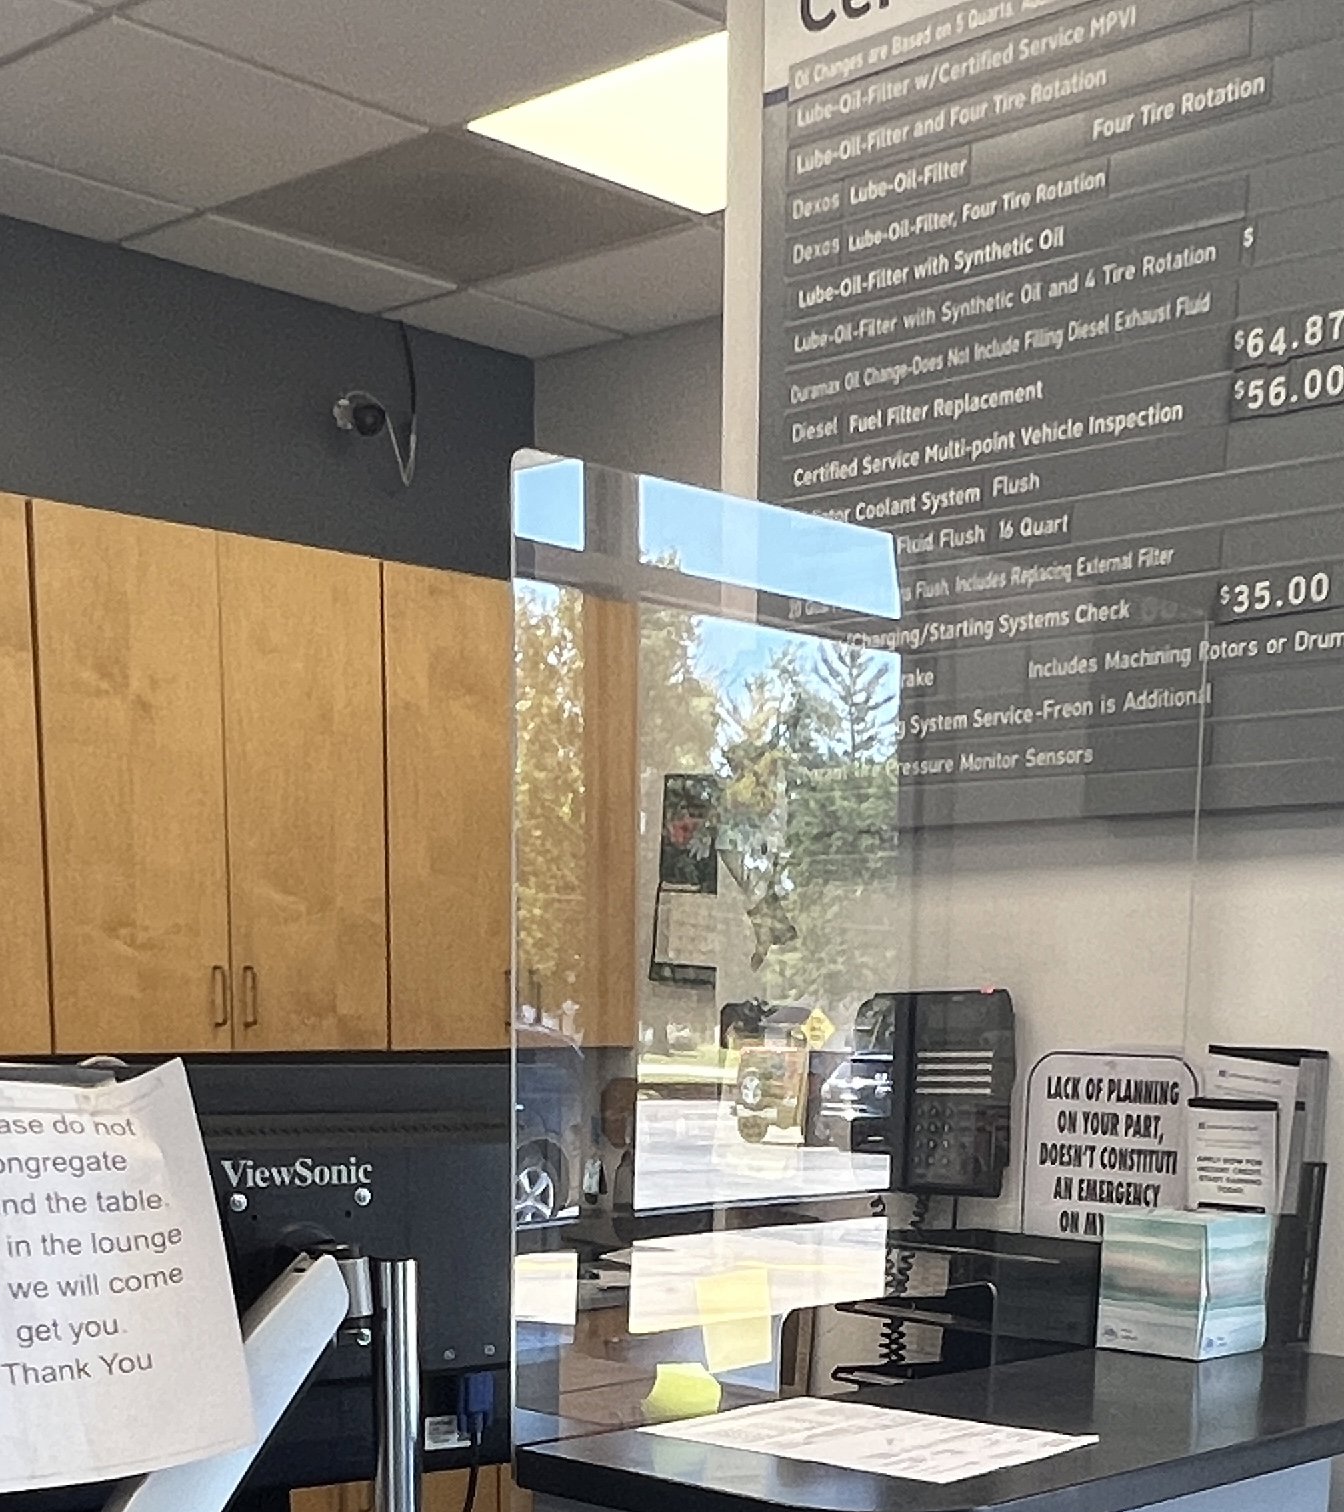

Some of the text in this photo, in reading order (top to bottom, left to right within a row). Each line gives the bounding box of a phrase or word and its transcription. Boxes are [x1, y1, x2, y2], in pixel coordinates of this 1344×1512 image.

[797, 5, 1136, 128] Lube-Oil-Filter w/Certified Service MPVI
[796, 69, 1107, 175] Lube-Oil-Filter and Four Tire Rotation
[850, 76, 1266, 205] Lube-Oil-Filter Four Tire Rotation
[962, 199, 997, 223] Four
[1003, 190, 1031, 212] Tire
[1036, 171, 1106, 204] Rotation
[798, 226, 1064, 308] Lube-Oil-Filter with Synthetic Oil
[794, 226, 1254, 353] Lube-Oil-Filter with Synthetic Oil and 4 Tire Rotation $
[1068, 291, 1212, 341] Diesel Exhaust Fluid
[792, 416, 838, 443] Diesel
[849, 409, 882, 434] Fuel
[886, 403, 929, 427] Filter
[933, 380, 1044, 420] Replacement
[793, 457, 858, 487] Certified
[862, 450, 919, 476] Service
[924, 431, 1016, 463] Multi-point
[1020, 416, 1083, 445] Vehicle
[1088, 403, 1184, 437] Inspection
[856, 494, 916, 521] Coolant
[921, 486, 982, 515] System
[992, 472, 1041, 498] Flush
[940, 513, 1069, 549] Flush 16 Quart
[955, 546, 1174, 592] Includes External Filter
[998, 571, 1330, 637] Systems Check $35.00
[1027, 654, 1098, 680] Includes
[1105, 645, 1192, 671] Machining
[1198, 637, 1258, 661] Rotors
[1266, 635, 1288, 655] or
[910, 711, 968, 739] System
[1100, 693, 1116, 714] is
[1122, 681, 1212, 712] Additional
[959, 746, 1094, 773] Monitor Sensors
[1046, 1076, 1180, 1106] LACK OF PLANNING
[53, 1114, 86, 1137] do
[93, 1116, 136, 1138] not
[1057, 1111, 1077, 1134] ON
[1082, 1111, 1119, 1138] YOUR
[1124, 1114, 1164, 1145] PART,
[221, 1156, 373, 1188] ViewSonic
[1039, 1142, 1096, 1169] DOESN'T
[45, 1191, 88, 1215] the
[96, 1188, 171, 1213] table.
[1053, 1176, 1161, 1209] AN EMERGENCY
[6, 1233, 33, 1258] in
[40, 1233, 83, 1258] the
[91, 1224, 183, 1258] lounge
[1059, 1210, 1080, 1234] ON
[7, 1281, 50, 1301] we
[57, 1271, 100, 1297] will
[109, 1265, 184, 1296] come
[16, 1316, 128, 1348] get you.
[2, 1350, 154, 1387] Thank You
